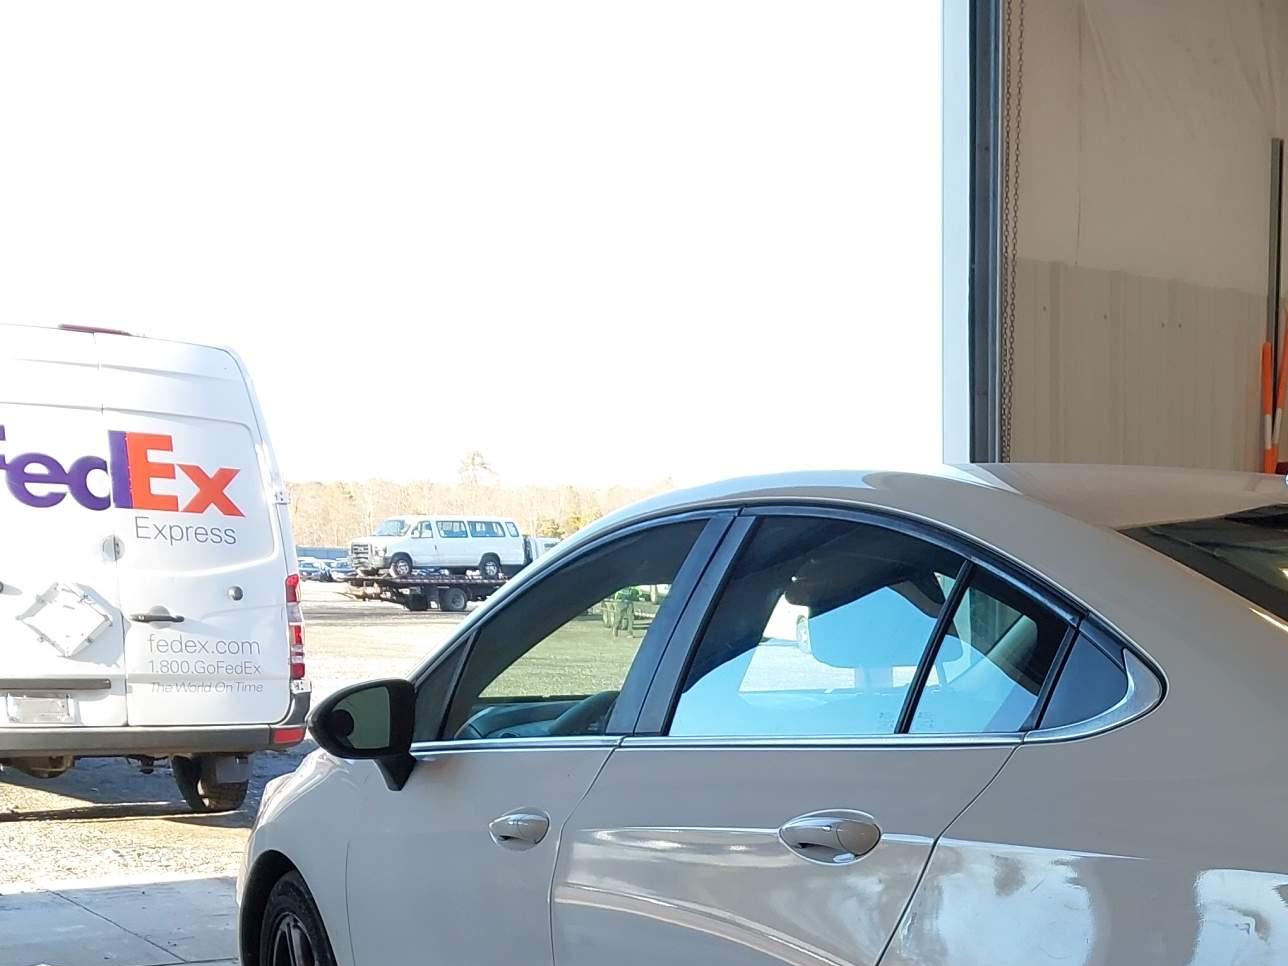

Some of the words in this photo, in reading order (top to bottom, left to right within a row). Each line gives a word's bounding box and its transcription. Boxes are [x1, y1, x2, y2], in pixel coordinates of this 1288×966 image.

[0, 425, 246, 518] edEx
[134, 516, 237, 546] Express
[148, 633, 261, 655] fedex.com
[148, 659, 262, 675] 1.800.GoFedEx
[151, 681, 173, 693] The
[175, 681, 212, 693] World
